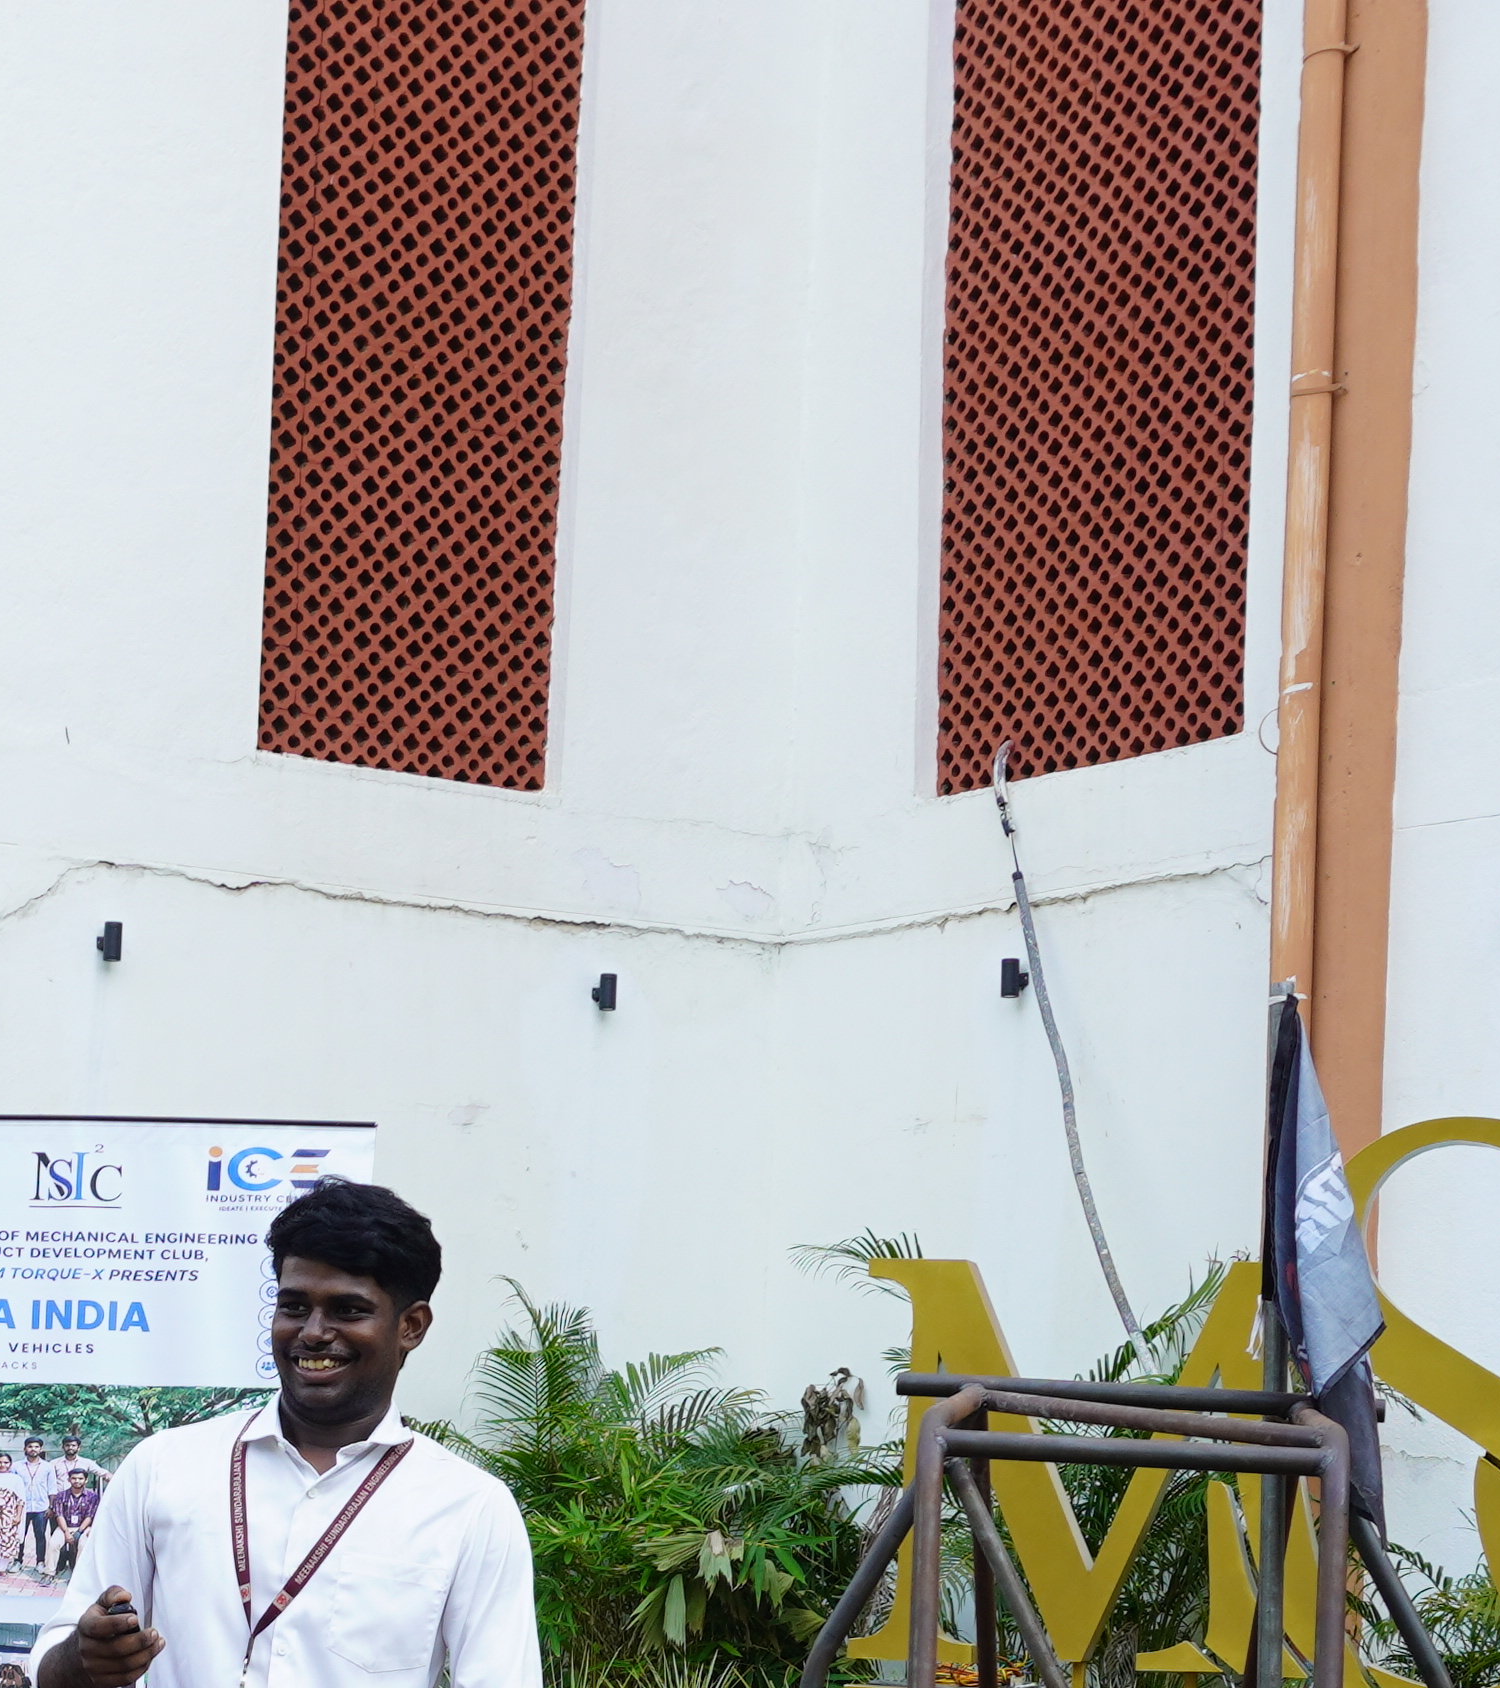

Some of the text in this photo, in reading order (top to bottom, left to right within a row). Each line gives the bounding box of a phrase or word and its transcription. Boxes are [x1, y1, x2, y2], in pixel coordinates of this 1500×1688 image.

[205, 1194, 272, 1203] INDUSTRY
[25, 1230, 140, 1244] MECHANICAL
[145, 1231, 259, 1245] ENGINEERING
[30, 1246, 156, 1260] DEVELOPMENT
[160, 1248, 210, 1263] CLUB,
[11, 1266, 104, 1282] TORQUE-X
[108, 1268, 200, 1282] PRESENTS
[31, 1299, 150, 1332] INDIA
[8, 1342, 96, 1354] VEHICLES
[294, 1543, 329, 1585] MEENAKSHI
[324, 1489, 369, 1546] SUNDARARAJAN
[364, 1451, 400, 1492] ENGINEERING
